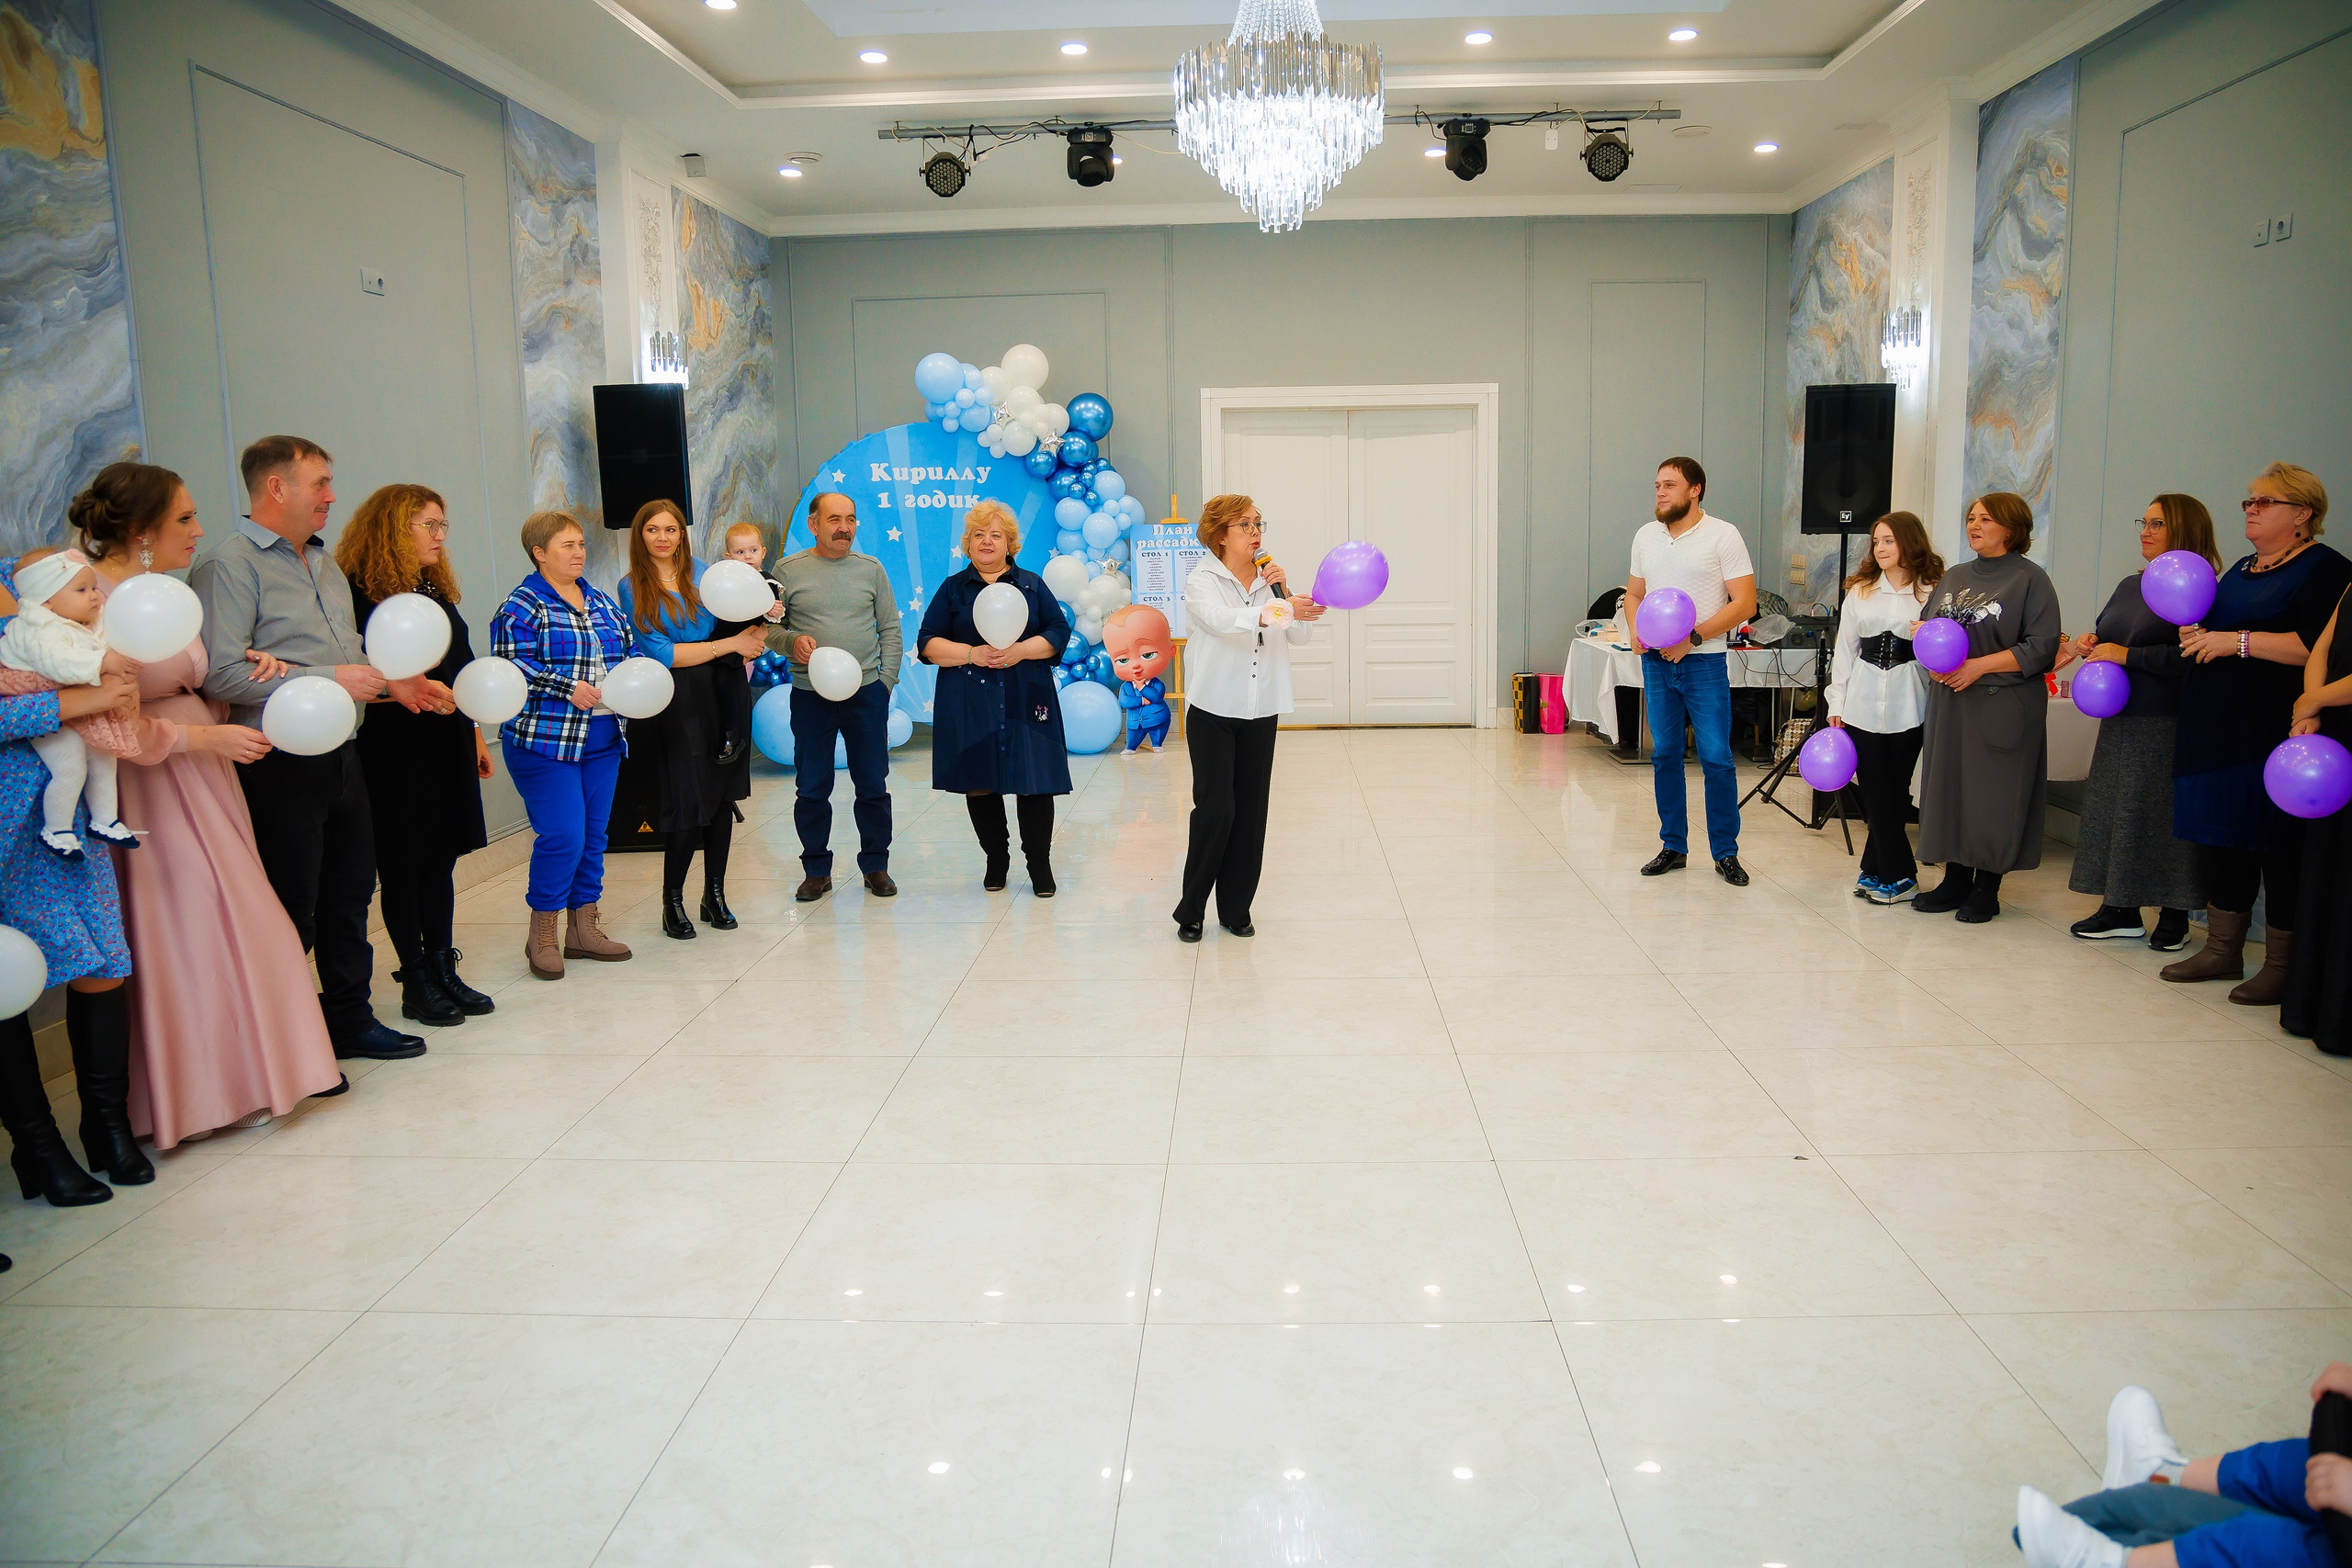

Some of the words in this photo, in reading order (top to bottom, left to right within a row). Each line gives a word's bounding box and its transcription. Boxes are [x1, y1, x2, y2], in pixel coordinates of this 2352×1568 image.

[870, 463, 991, 484] Кириллу
[878, 492, 891, 508] 1
[904, 490, 980, 509] годик
[1152, 525, 1193, 536] План
[1136, 536, 1199, 549] рассадк
